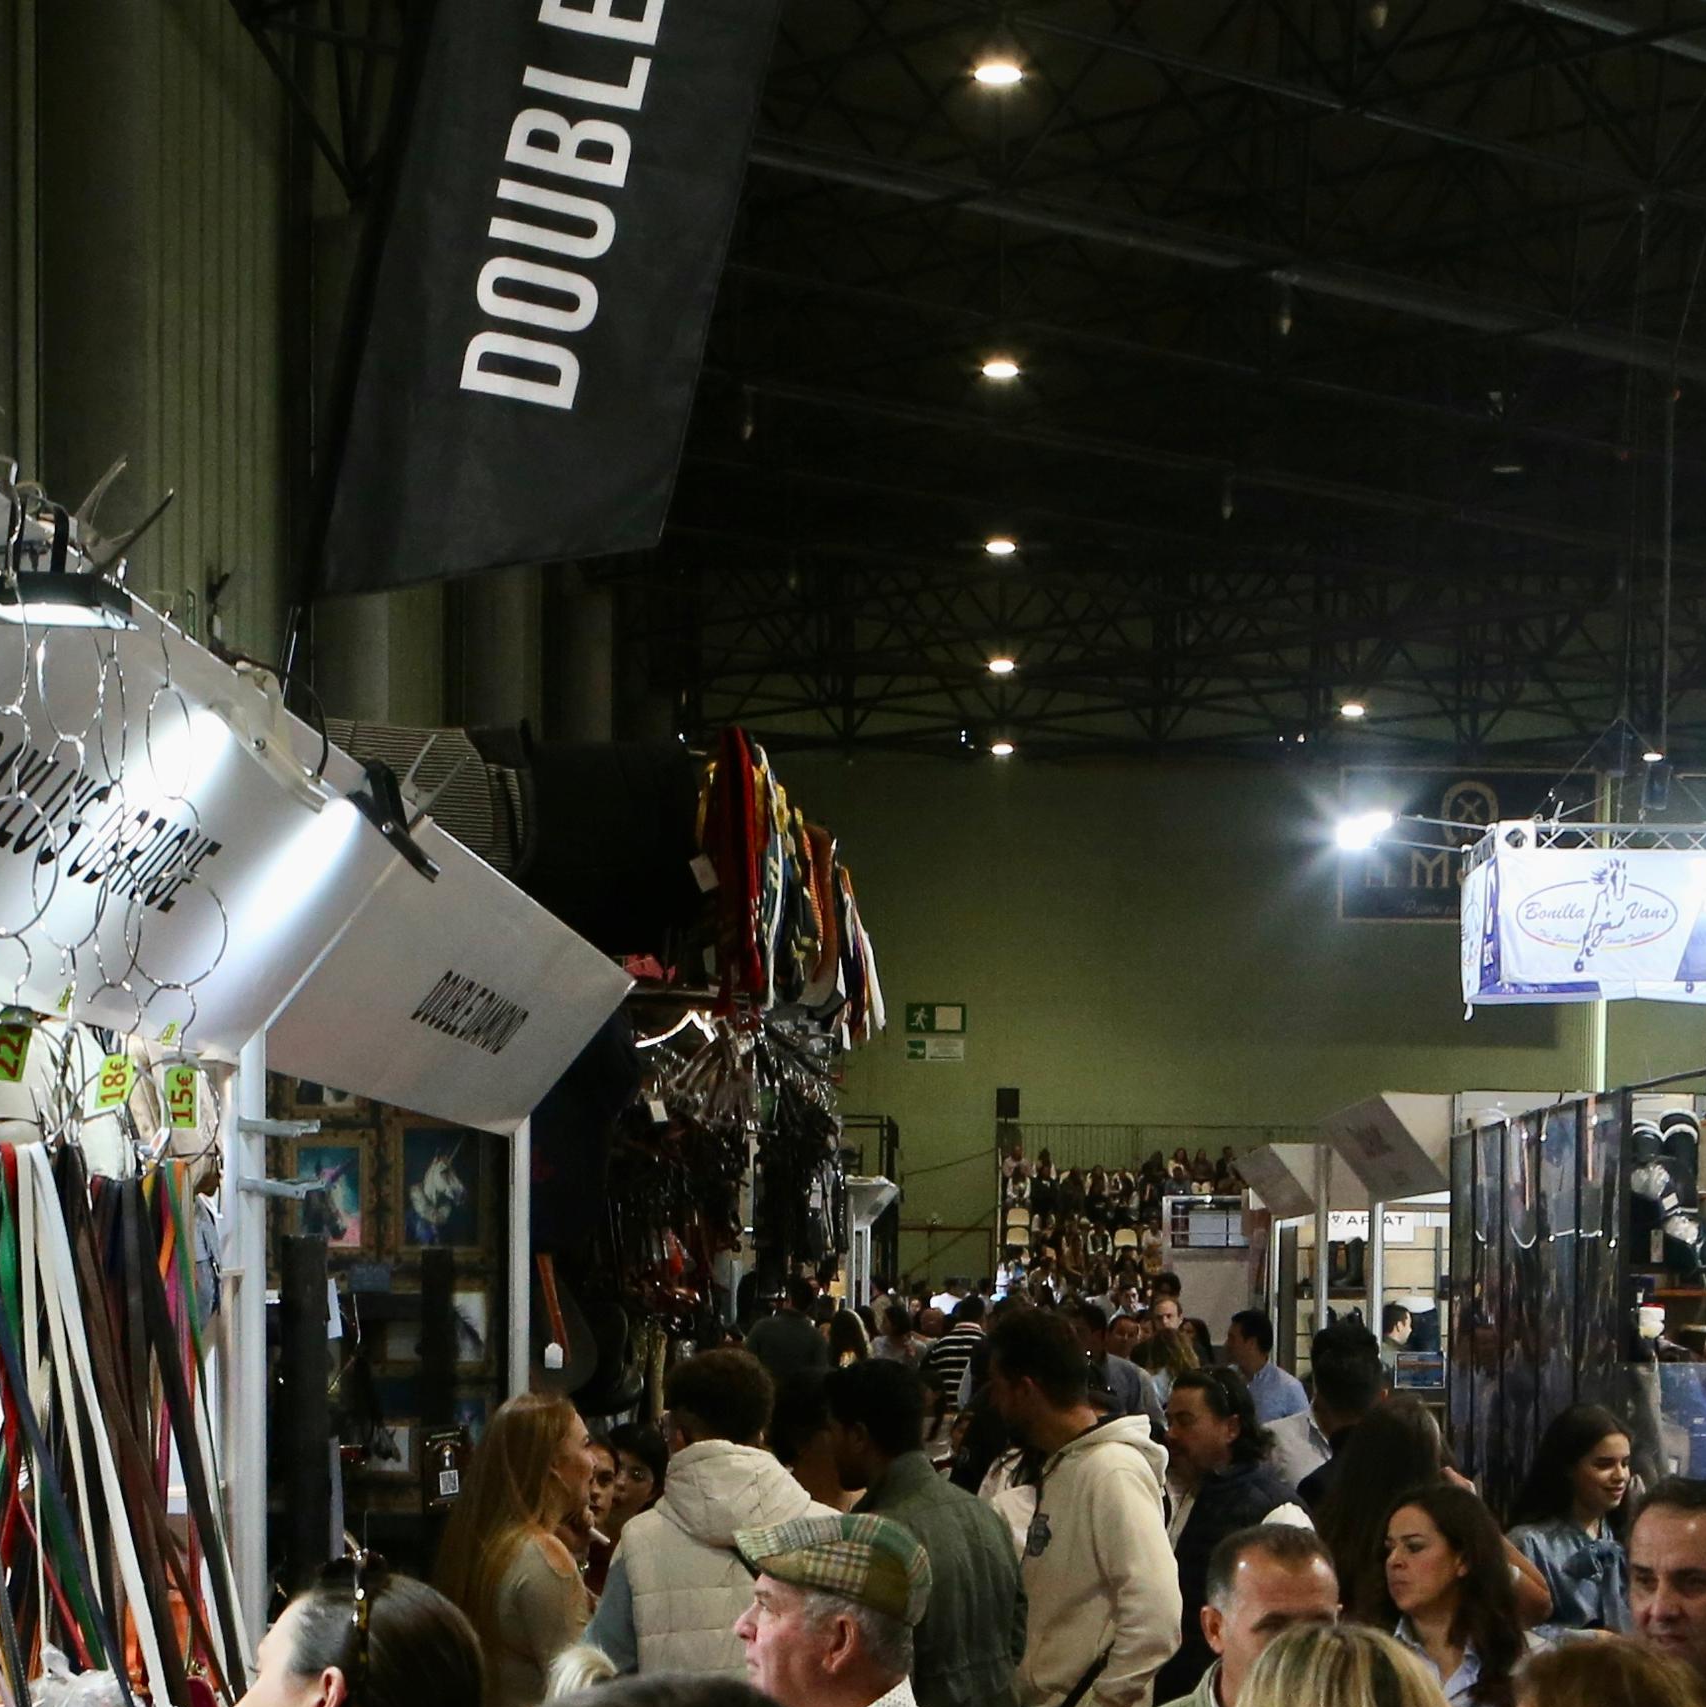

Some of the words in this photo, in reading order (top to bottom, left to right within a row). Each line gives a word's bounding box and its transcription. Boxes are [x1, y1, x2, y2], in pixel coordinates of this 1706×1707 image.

[460, 0, 665, 410] DOUBLE
[1524, 902, 1586, 920] Bonilla
[1625, 900, 1670, 920] Vans
[100, 1060, 128, 1104] 18€
[170, 1071, 194, 1123] 15€
